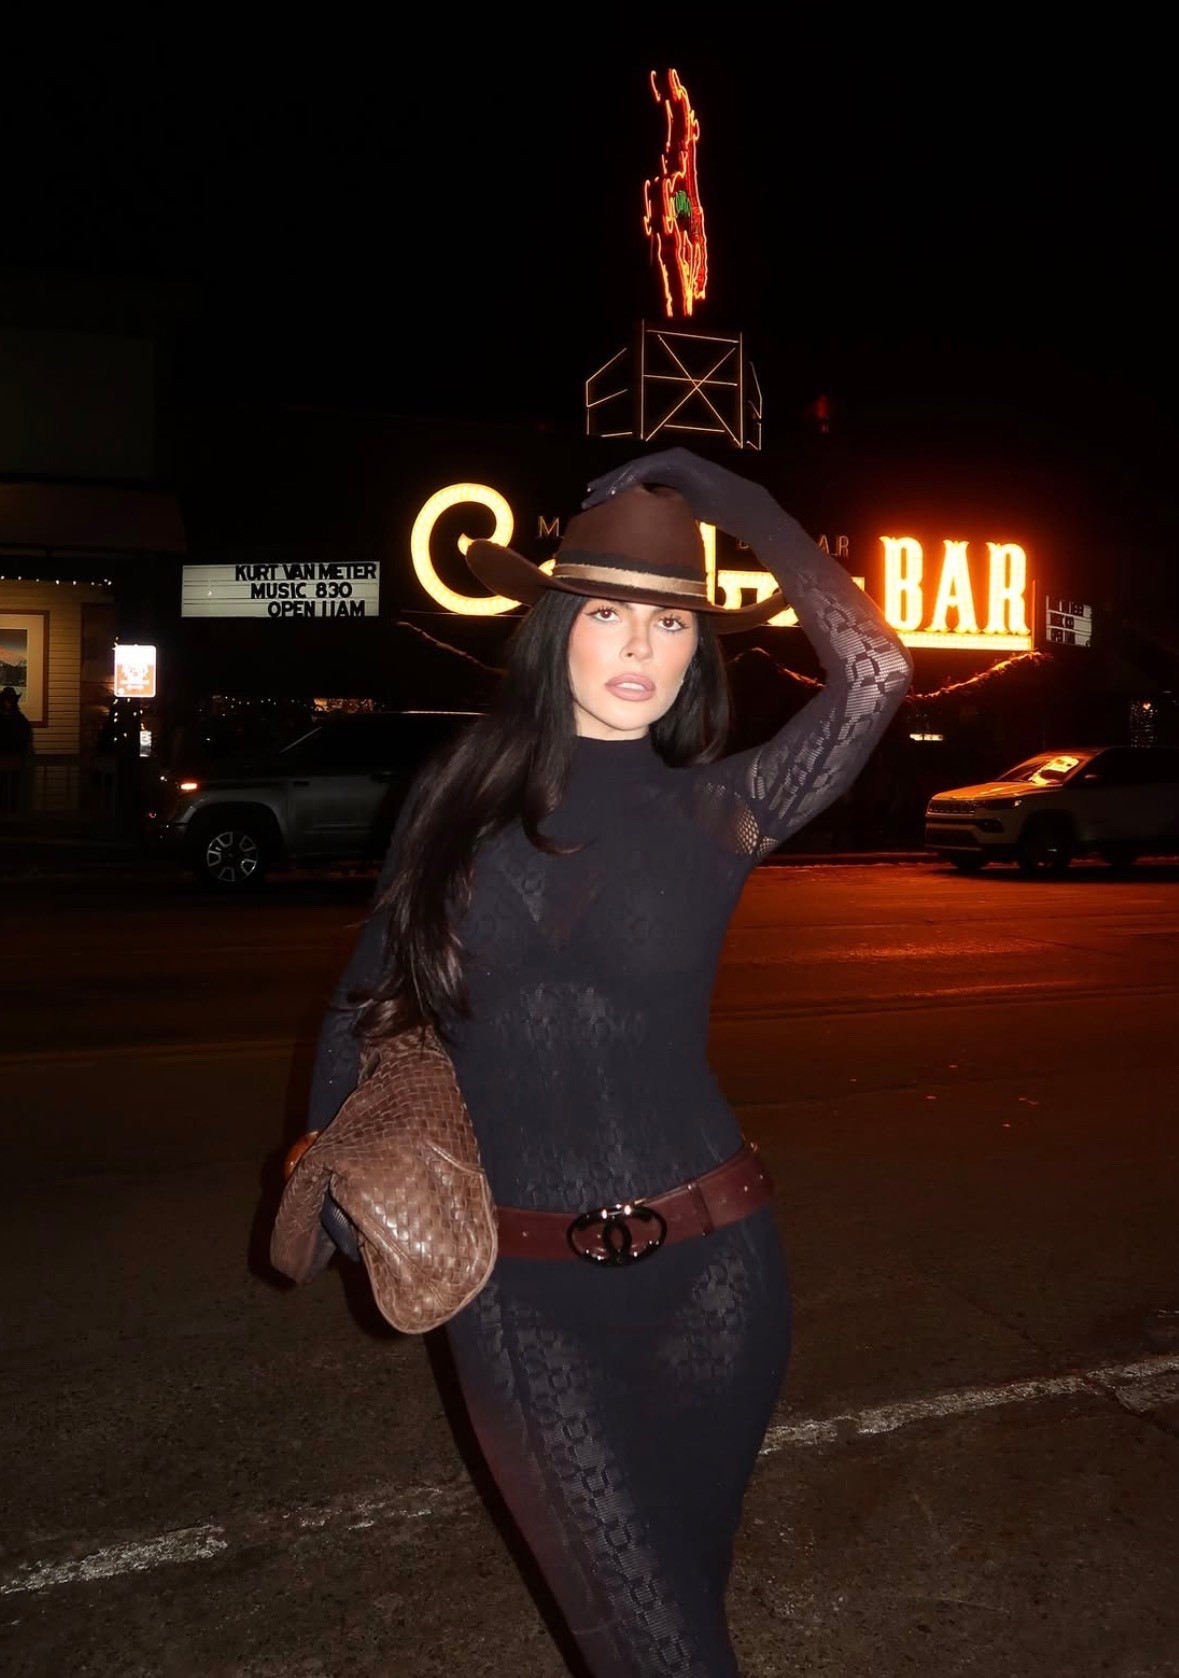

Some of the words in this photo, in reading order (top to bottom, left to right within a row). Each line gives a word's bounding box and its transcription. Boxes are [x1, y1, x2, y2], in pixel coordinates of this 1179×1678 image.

[235, 564, 279, 581] KURT
[282, 563, 315, 580] VAN
[318, 562, 377, 580] METER
[251, 583, 307, 599] MUSIC
[315, 582, 353, 598] 830
[879, 536, 1031, 634] BAR
[267, 600, 316, 617] OPEN
